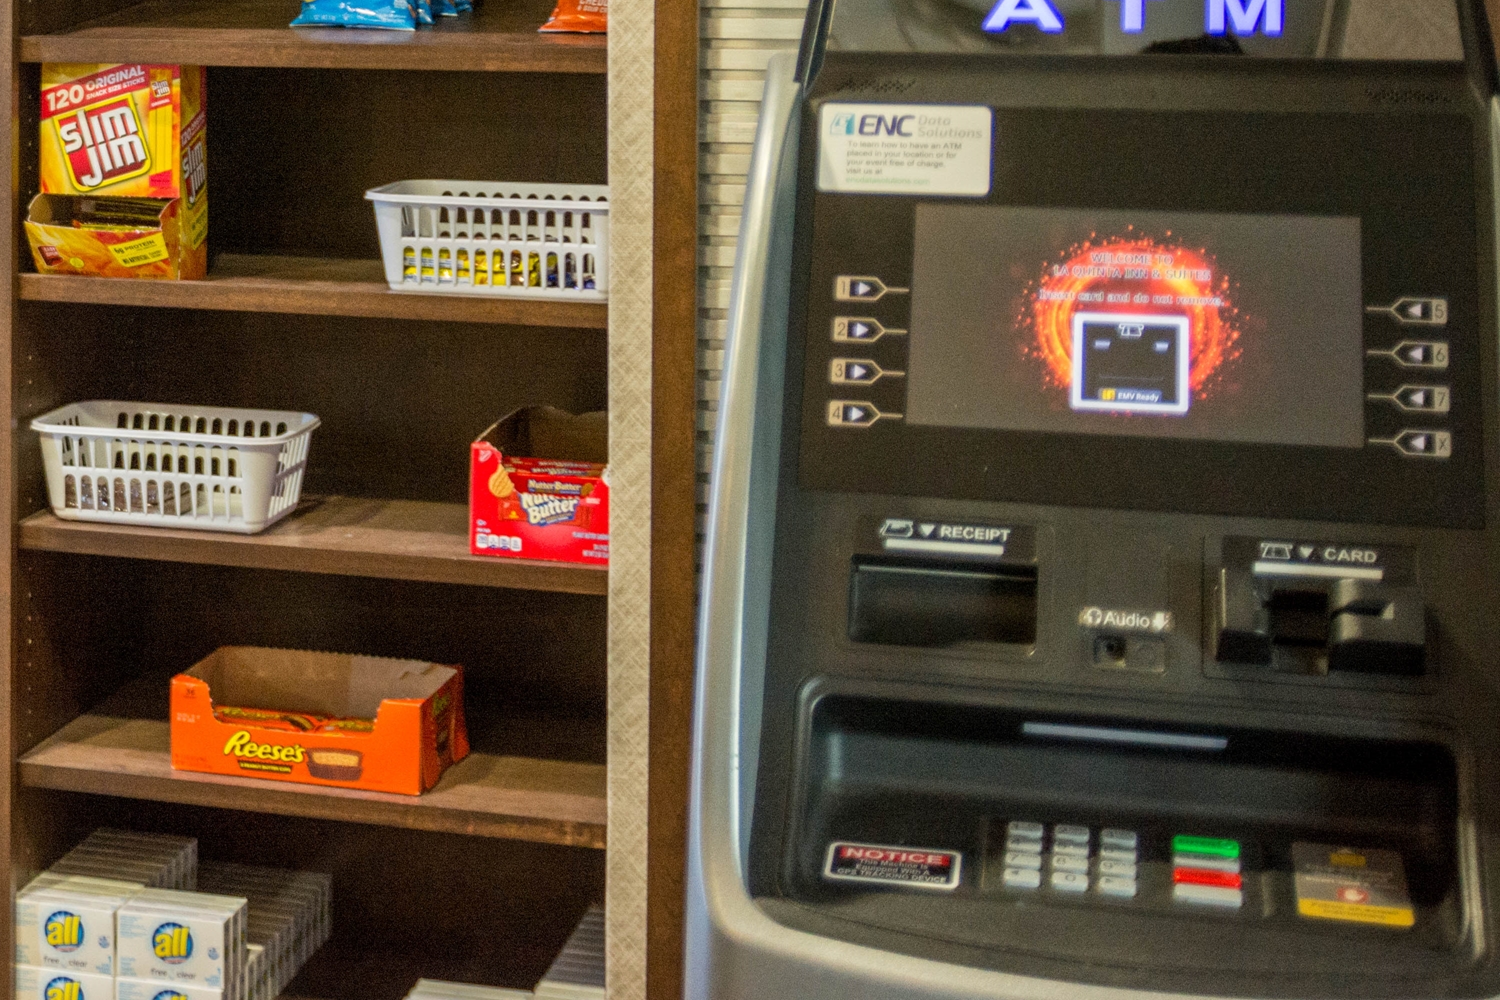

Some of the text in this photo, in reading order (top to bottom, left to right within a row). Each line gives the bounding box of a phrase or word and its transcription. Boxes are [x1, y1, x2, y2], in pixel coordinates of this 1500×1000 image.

[86, 65, 145, 92] ORIGINAL
[46, 84, 84, 112] 120
[859, 114, 915, 137] ENC
[918, 115, 951, 126] Data
[918, 128, 983, 138] Solutions
[860, 140, 879, 148] learn
[909, 141, 929, 149] have
[903, 151, 934, 159] location
[1091, 253, 1173, 265] WELCOME TO
[1054, 265, 1211, 280] LA QUINTA INN & SUITES
[842, 281, 846, 295] 1
[1039, 289, 1225, 307] Insert card and do not remove.
[1435, 304, 1444, 319] 5
[837, 322, 846, 336] 2
[1435, 348, 1445, 362] 6
[835, 364, 843, 378] 3
[1118, 392, 1159, 402] EMV Ready
[1438, 392, 1446, 406] 7
[832, 406, 841, 419] 4
[528, 499, 578, 524] Butter
[940, 524, 1011, 543] RECEIPT
[1324, 547, 1378, 563] CARD
[1104, 610, 1151, 629] Audio
[224, 730, 305, 763] Reese's
[846, 848, 944, 864] NOTICE
[860, 858, 878, 866] This
[880, 860, 917, 868] Machine
[856, 864, 899, 872] Equipped
[860, 870, 909, 880] TRACKING
[911, 874, 946, 883] DEVICE
[47, 915, 81, 945] all
[155, 926, 190, 958] all
